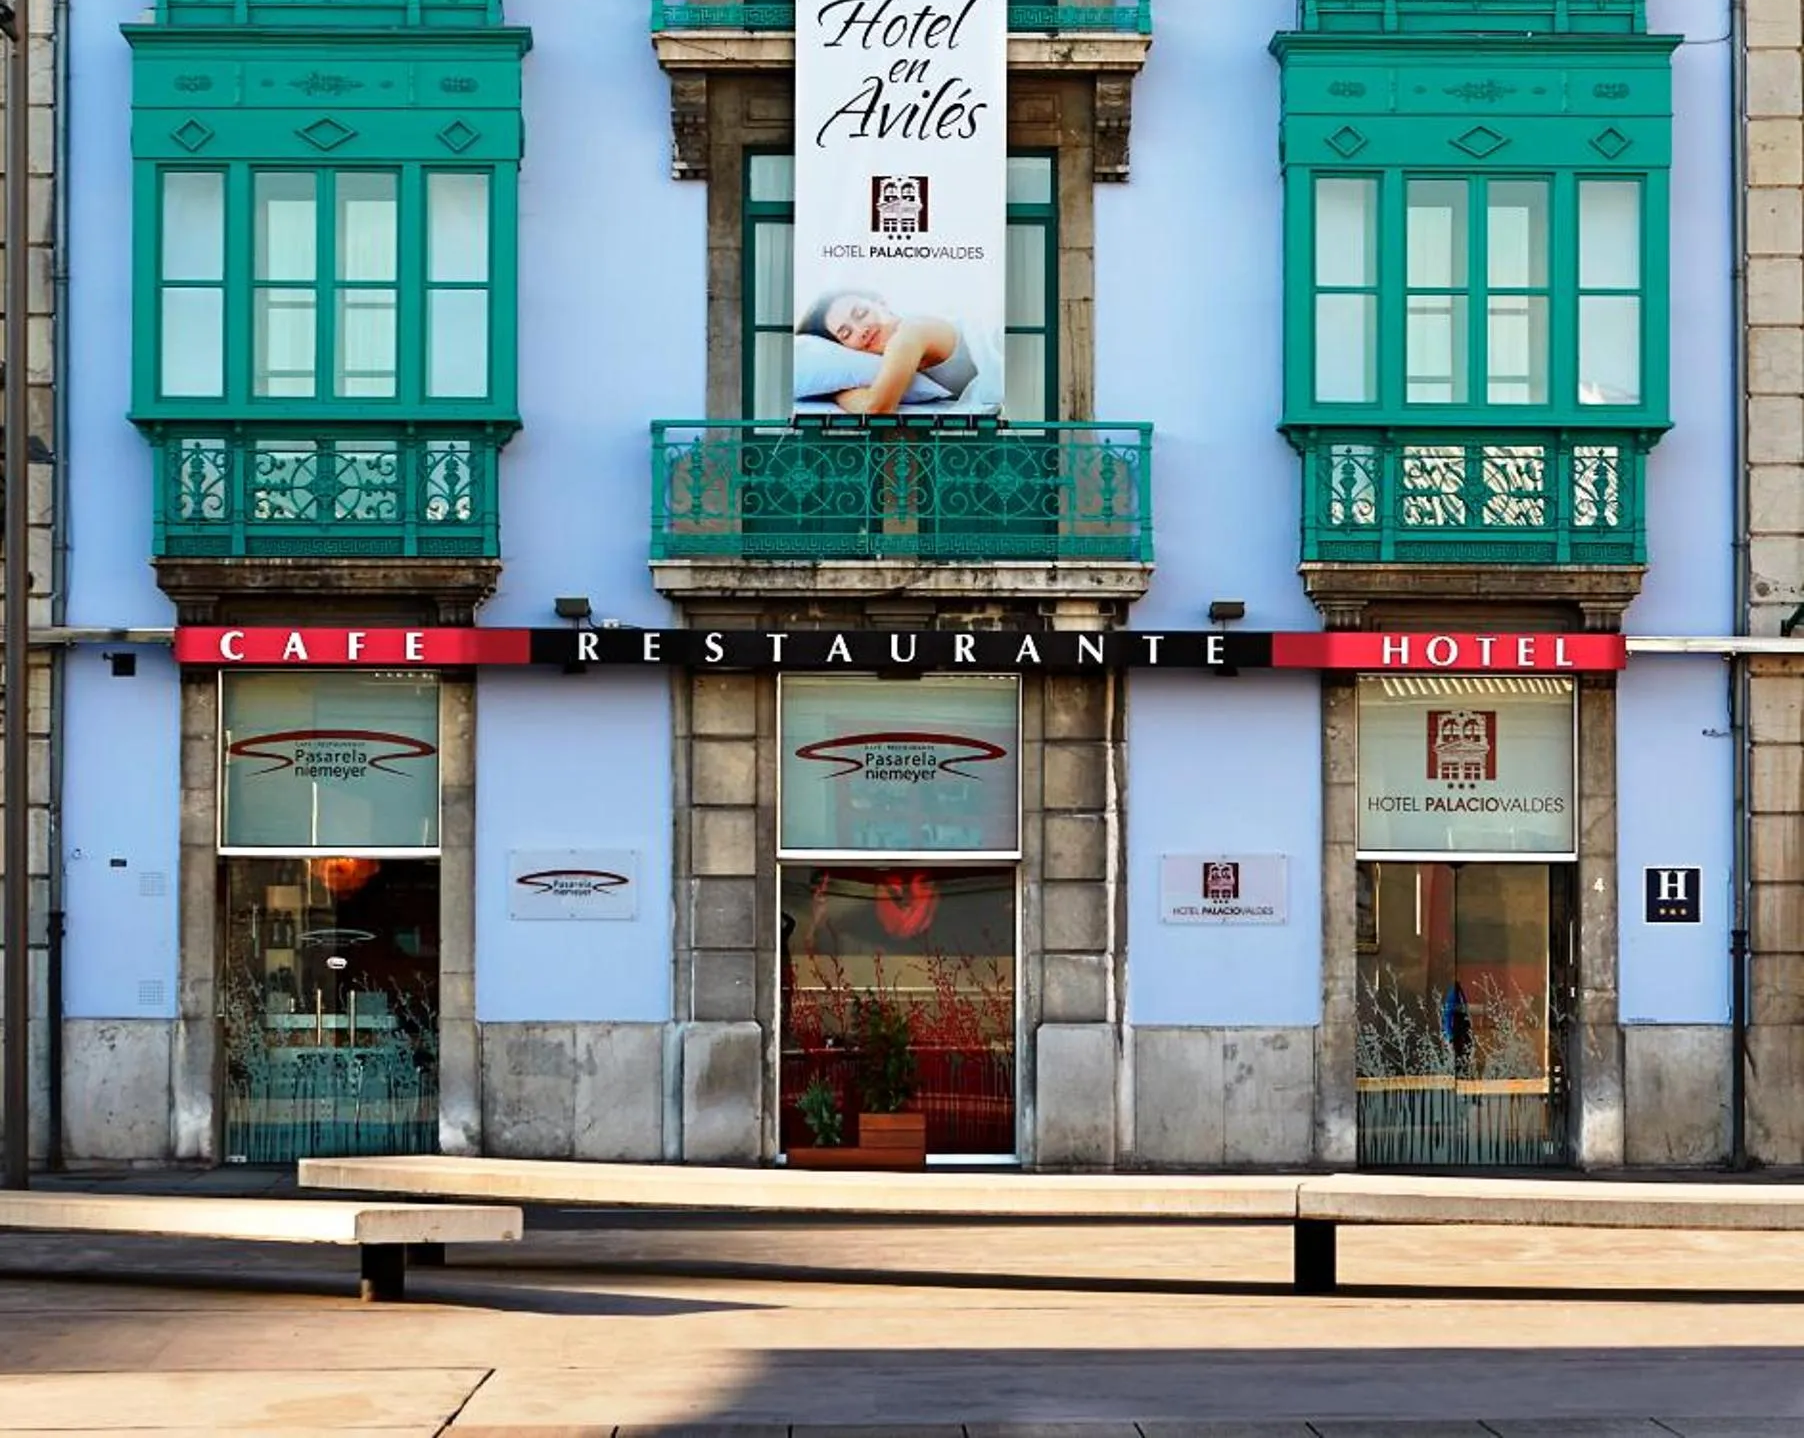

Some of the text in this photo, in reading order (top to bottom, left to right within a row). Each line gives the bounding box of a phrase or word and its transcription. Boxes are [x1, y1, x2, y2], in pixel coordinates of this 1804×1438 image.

[888, 58, 931, 84] en
[815, 75, 988, 148] Avilés
[822, 245, 865, 258] HOTEL
[219, 631, 424, 660] CAFE
[576, 633, 1225, 664] RESTAURANTE
[1383, 636, 1573, 666] HOTEL
[294, 749, 368, 763] Pasarela
[865, 752, 937, 767] Pasarela
[294, 766, 367, 781] niemeyer
[865, 767, 936, 784] niemeyer
[1368, 796, 1421, 812] HOTEL
[1656, 870, 1689, 900] H
